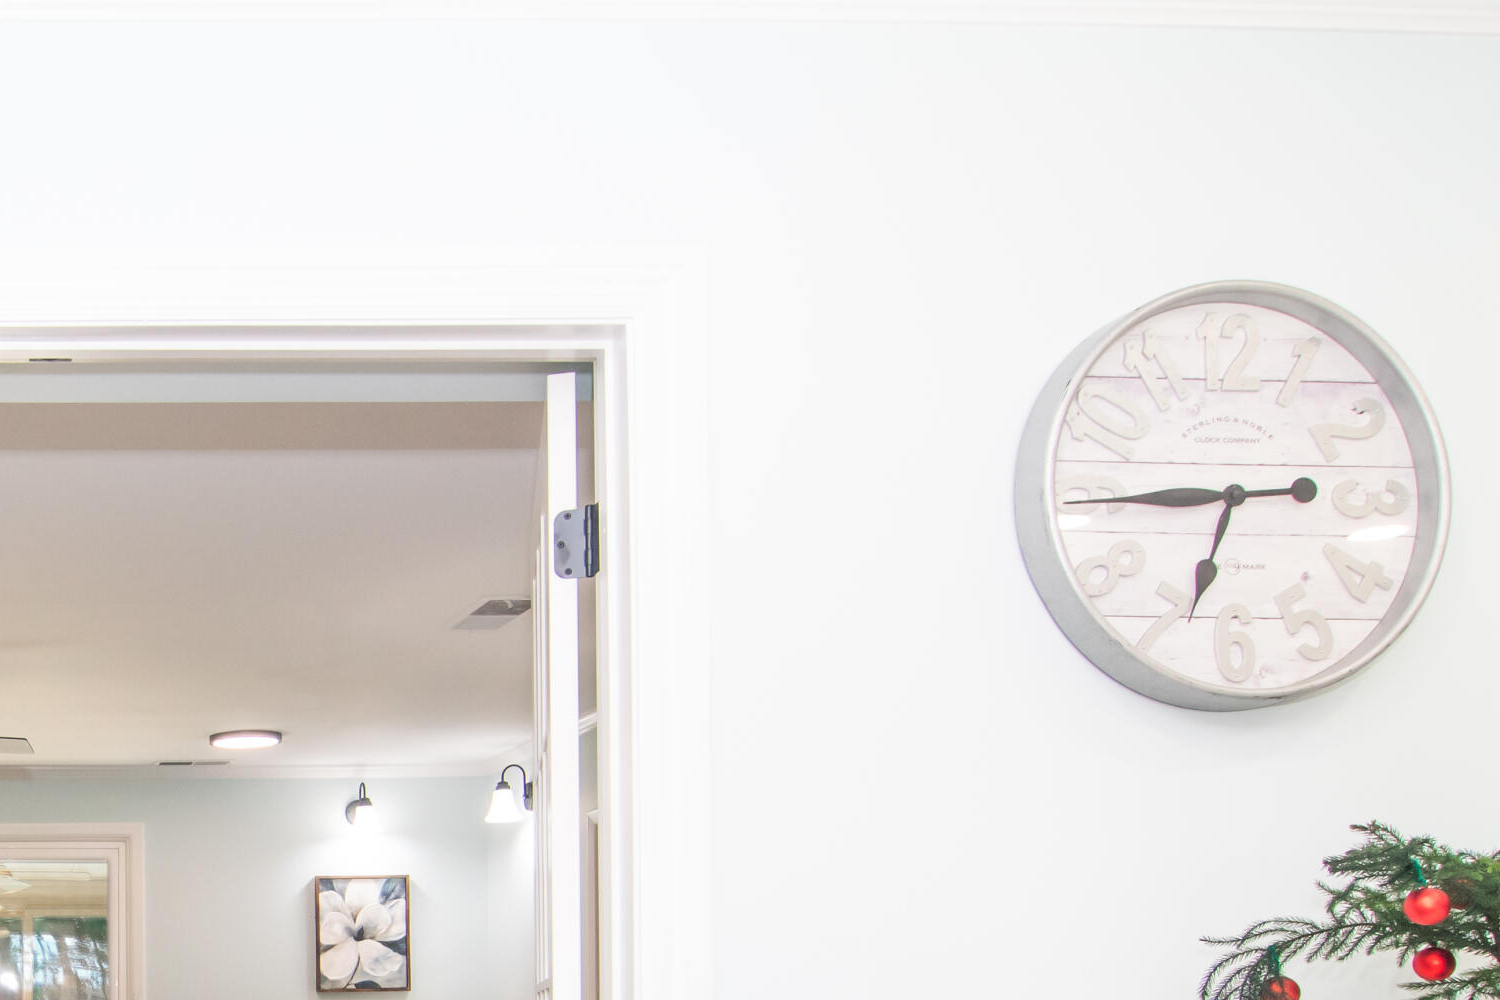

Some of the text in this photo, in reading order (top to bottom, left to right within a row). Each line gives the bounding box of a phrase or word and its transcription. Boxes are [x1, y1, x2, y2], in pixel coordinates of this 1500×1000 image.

[1123, 329, 1190, 411] 11
[1195, 311, 1261, 392] 12
[1275, 336, 1322, 408] 1
[1063, 384, 1151, 461] 10
[1308, 397, 1386, 462] 2
[1054, 475, 1127, 514] 9
[1332, 479, 1411, 518] 3
[1075, 540, 1146, 597] 8
[1322, 543, 1394, 603] 4
[1136, 581, 1193, 656] 7
[1214, 603, 1255, 683] 6
[1275, 583, 1333, 661] 5
